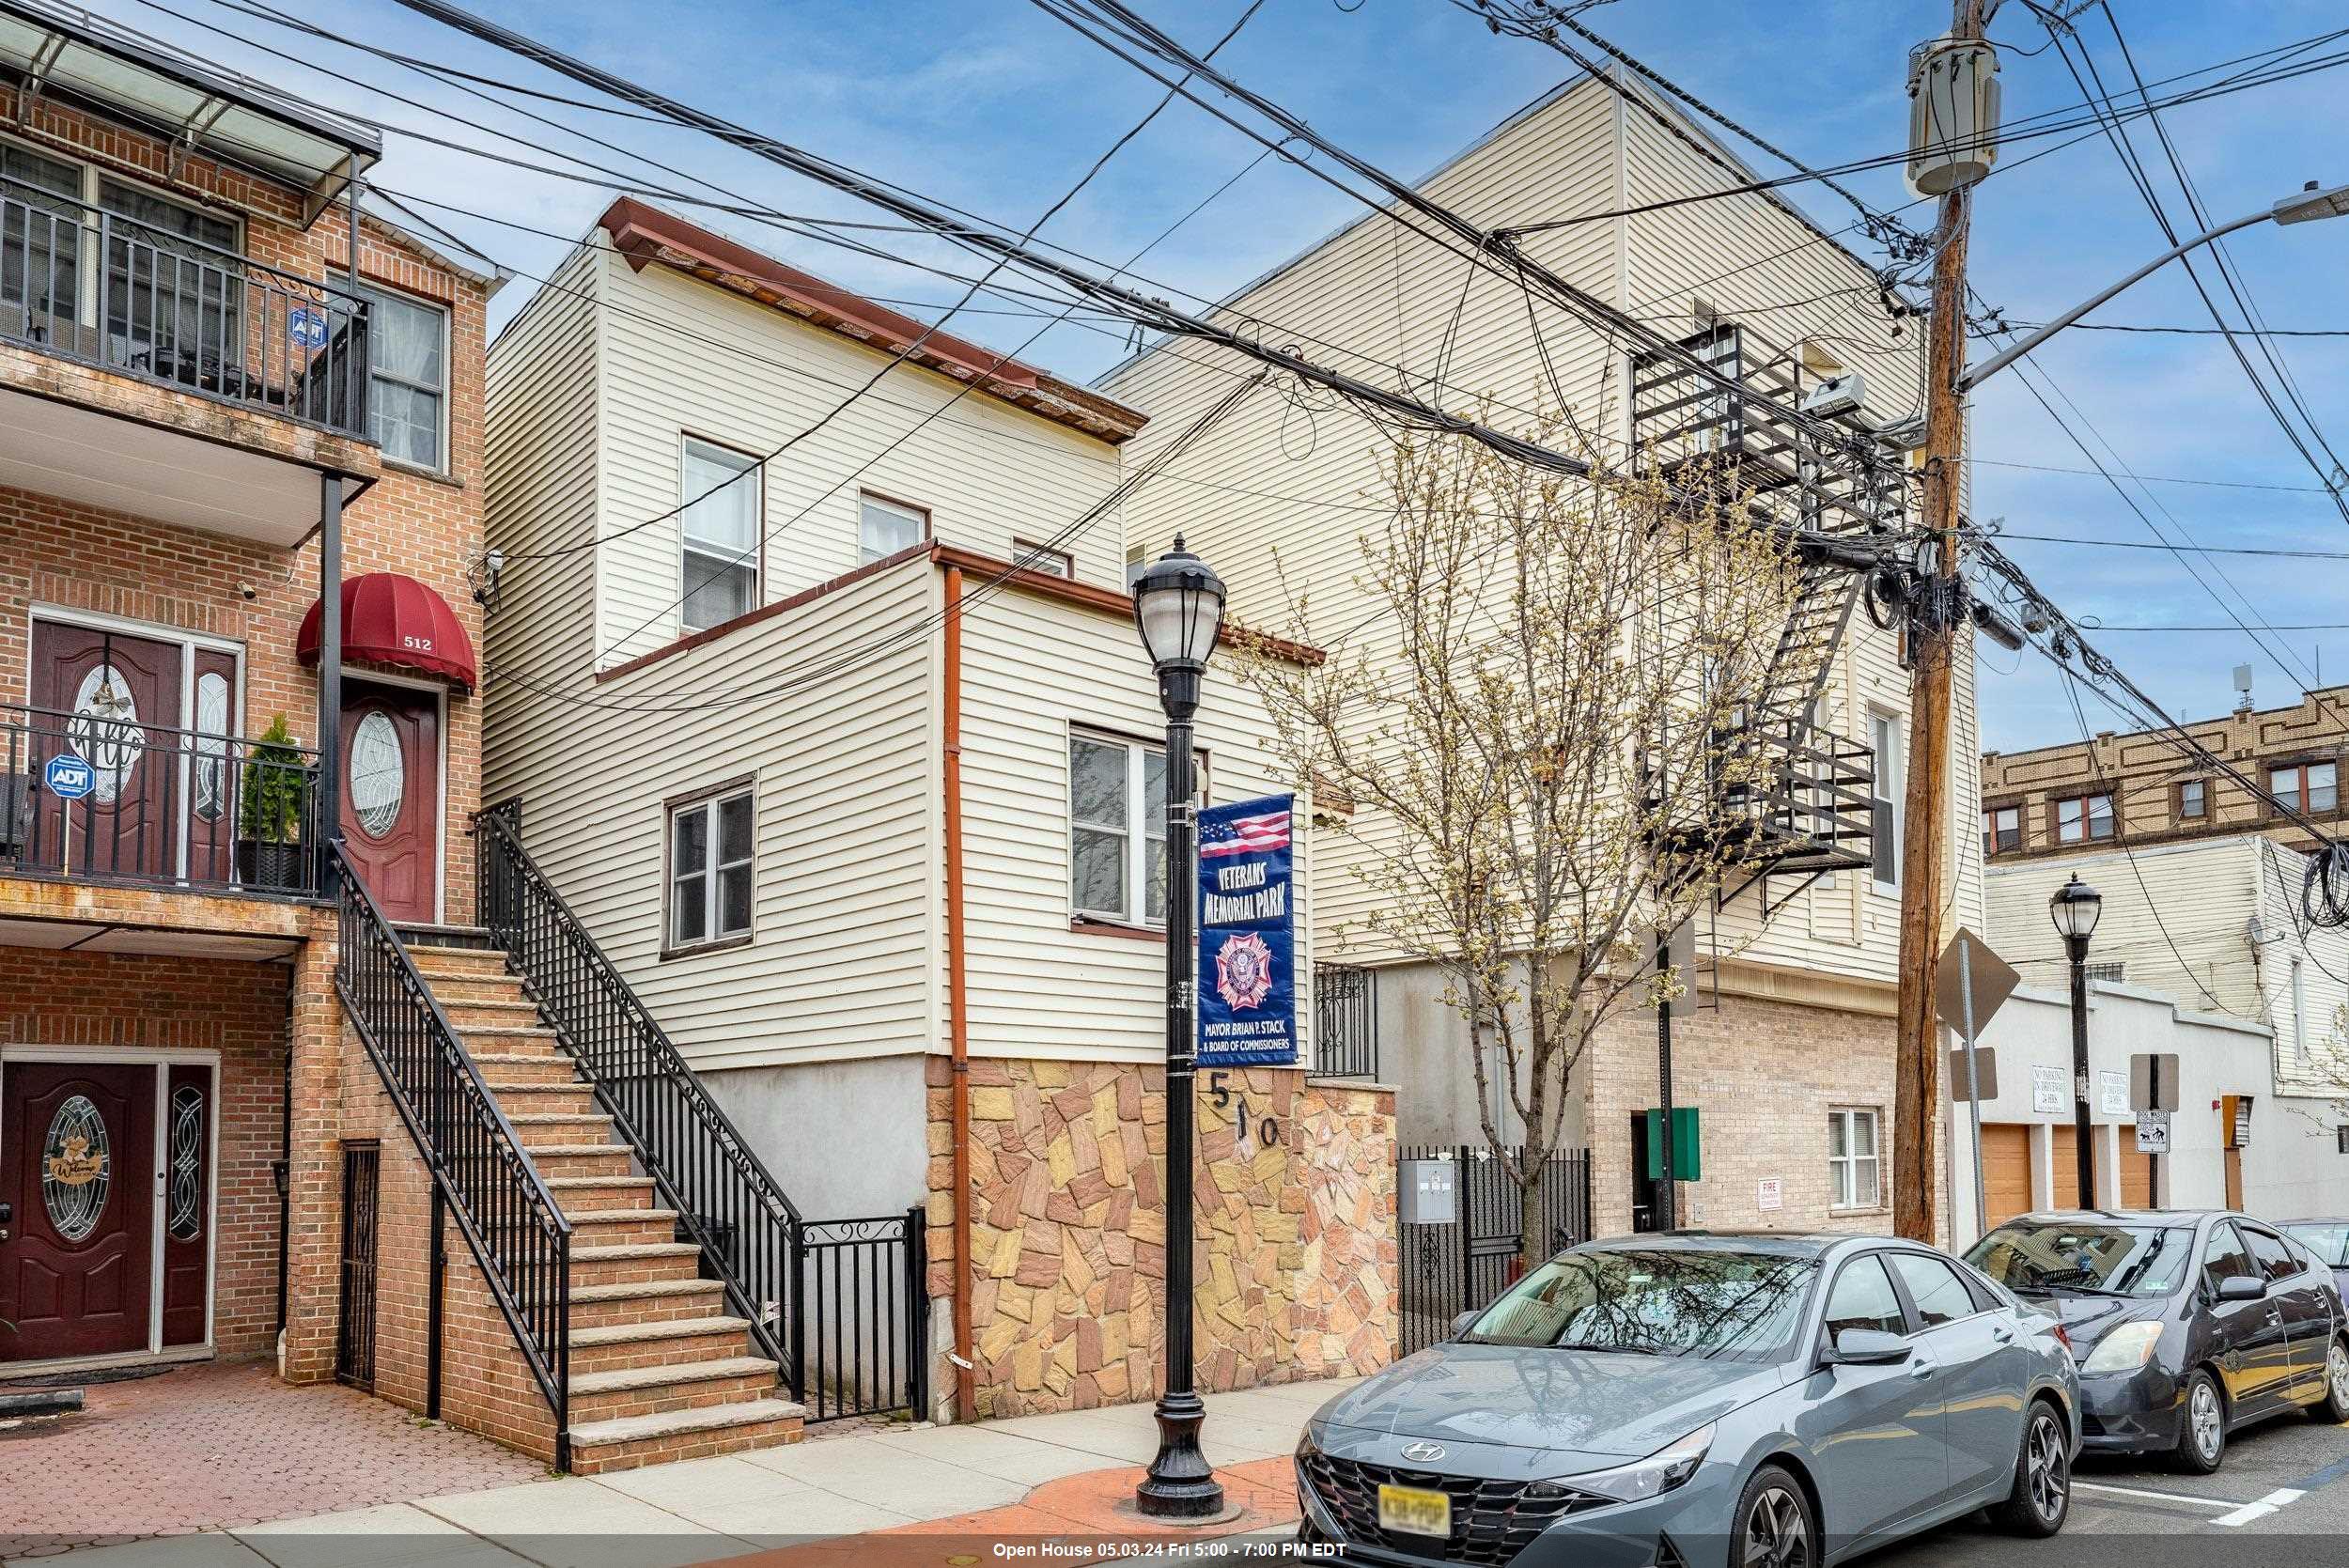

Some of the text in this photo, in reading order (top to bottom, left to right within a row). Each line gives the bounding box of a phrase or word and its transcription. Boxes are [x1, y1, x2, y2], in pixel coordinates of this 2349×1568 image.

[294, 320, 321, 339] AT
[404, 636, 432, 650] 512
[54, 768, 86, 785] ADT
[1219, 862, 1267, 891] VETERANS
[1205, 881, 1285, 924] MEMORIAL PARK
[1205, 1019, 1285, 1036] MAYOR BRIAN P. STACK
[1203, 1038, 1290, 1052] & BOARD OF COMMISSIONERS
[1763, 1182, 1776, 1192] FIRE
